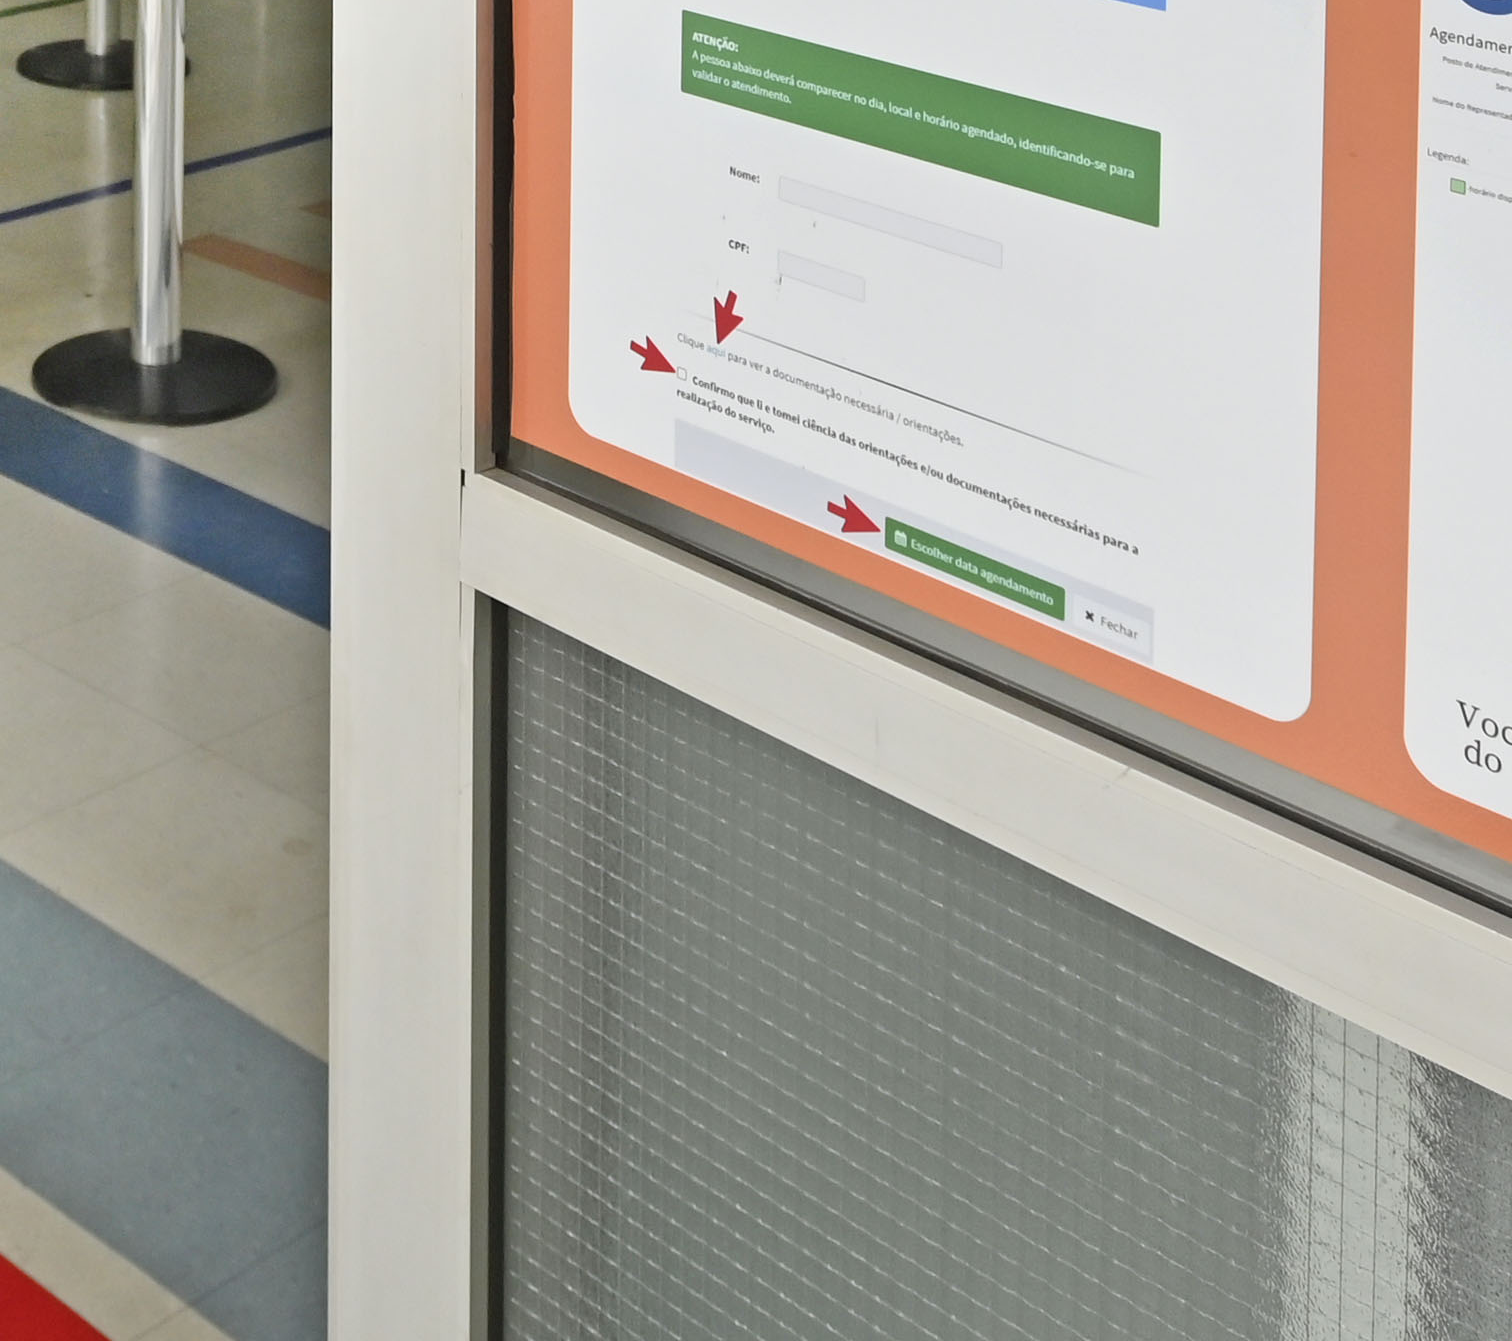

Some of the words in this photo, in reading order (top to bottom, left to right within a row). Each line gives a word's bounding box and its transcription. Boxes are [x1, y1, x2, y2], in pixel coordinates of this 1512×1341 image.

[729, 166, 760, 184] Nome:
[728, 239, 750, 254] CPF:
[910, 538, 954, 564] Escolher
[955, 557, 979, 575] data
[980, 568, 1054, 606] agendamento
[1100, 616, 1138, 640] Fechar
[1464, 739, 1502, 773] do
